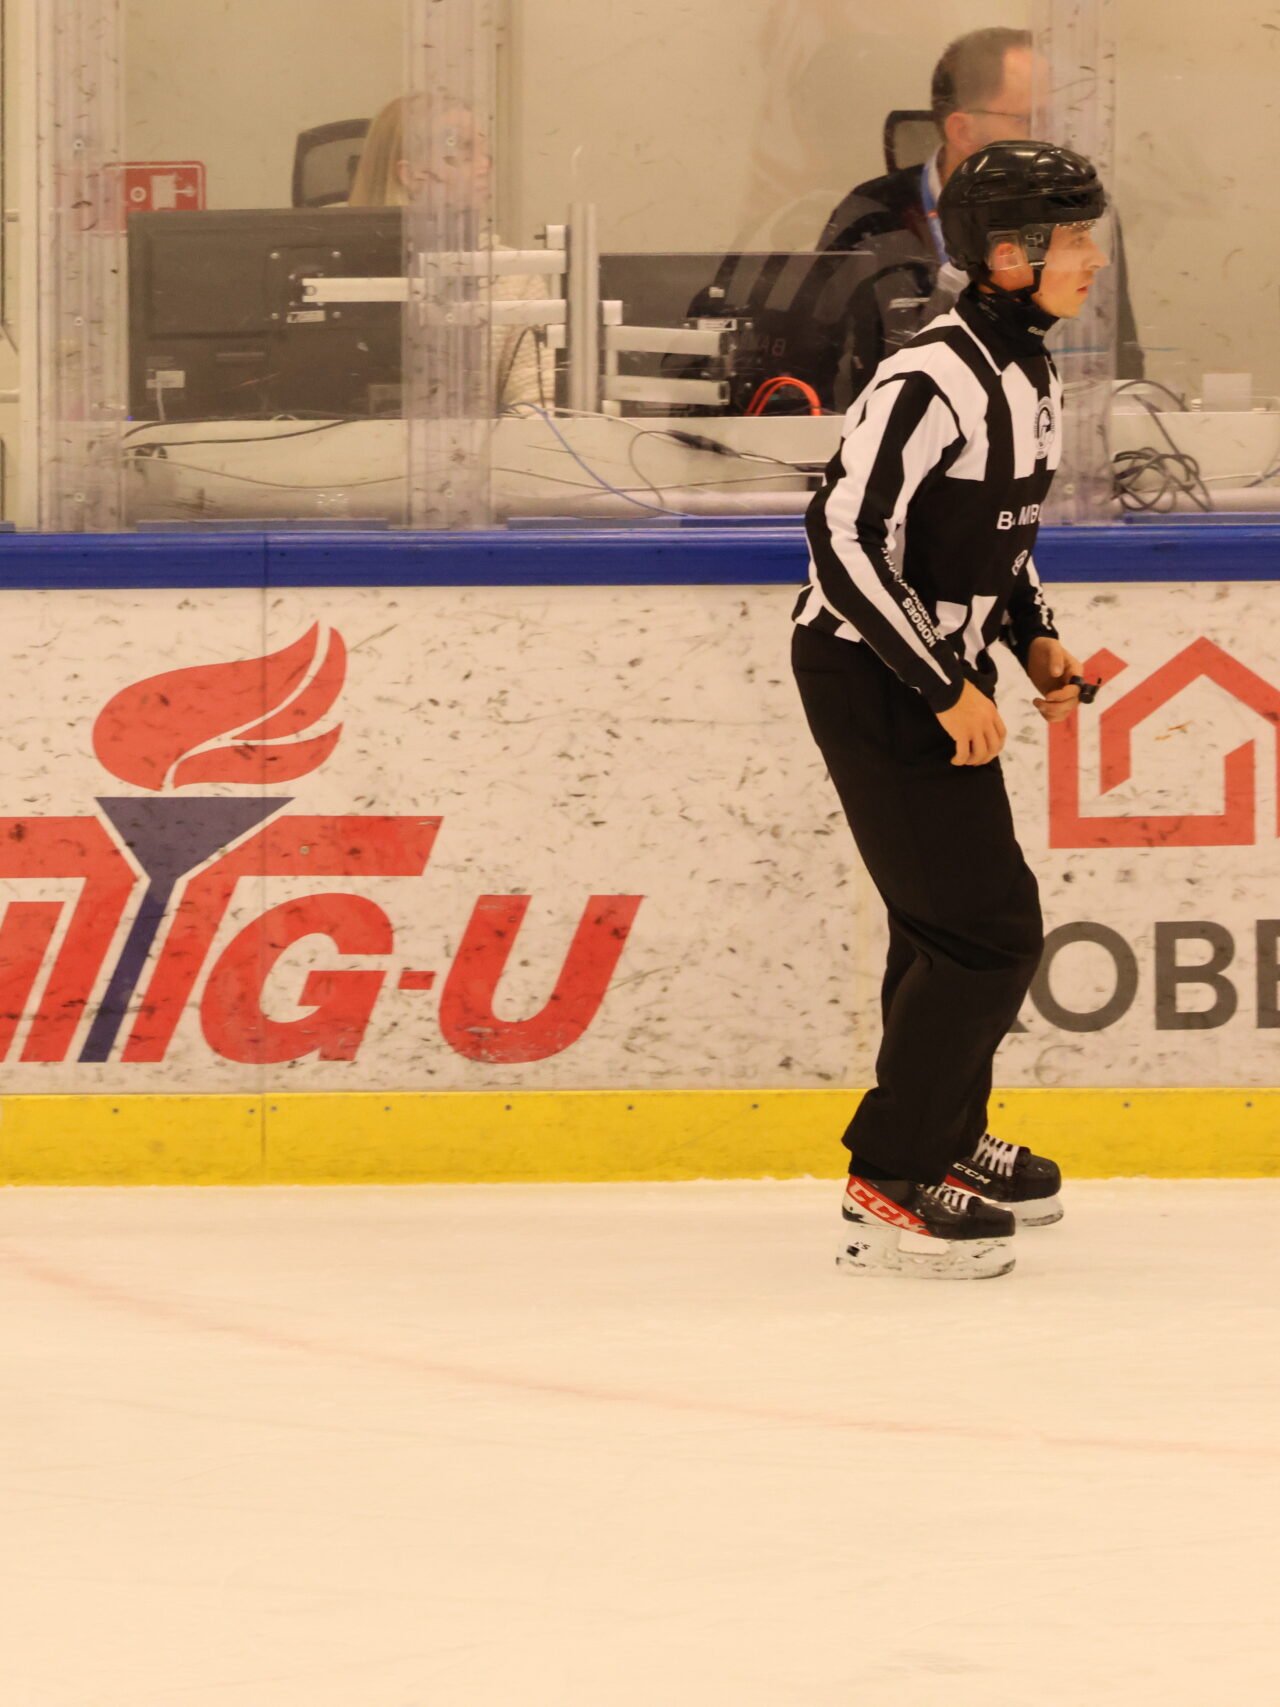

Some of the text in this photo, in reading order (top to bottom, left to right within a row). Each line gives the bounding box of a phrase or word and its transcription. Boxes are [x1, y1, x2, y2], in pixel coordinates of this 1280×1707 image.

[902, 597, 936, 647] NORGES
[952, 1162, 991, 1185] CCM
[849, 1182, 922, 1234] CCM
